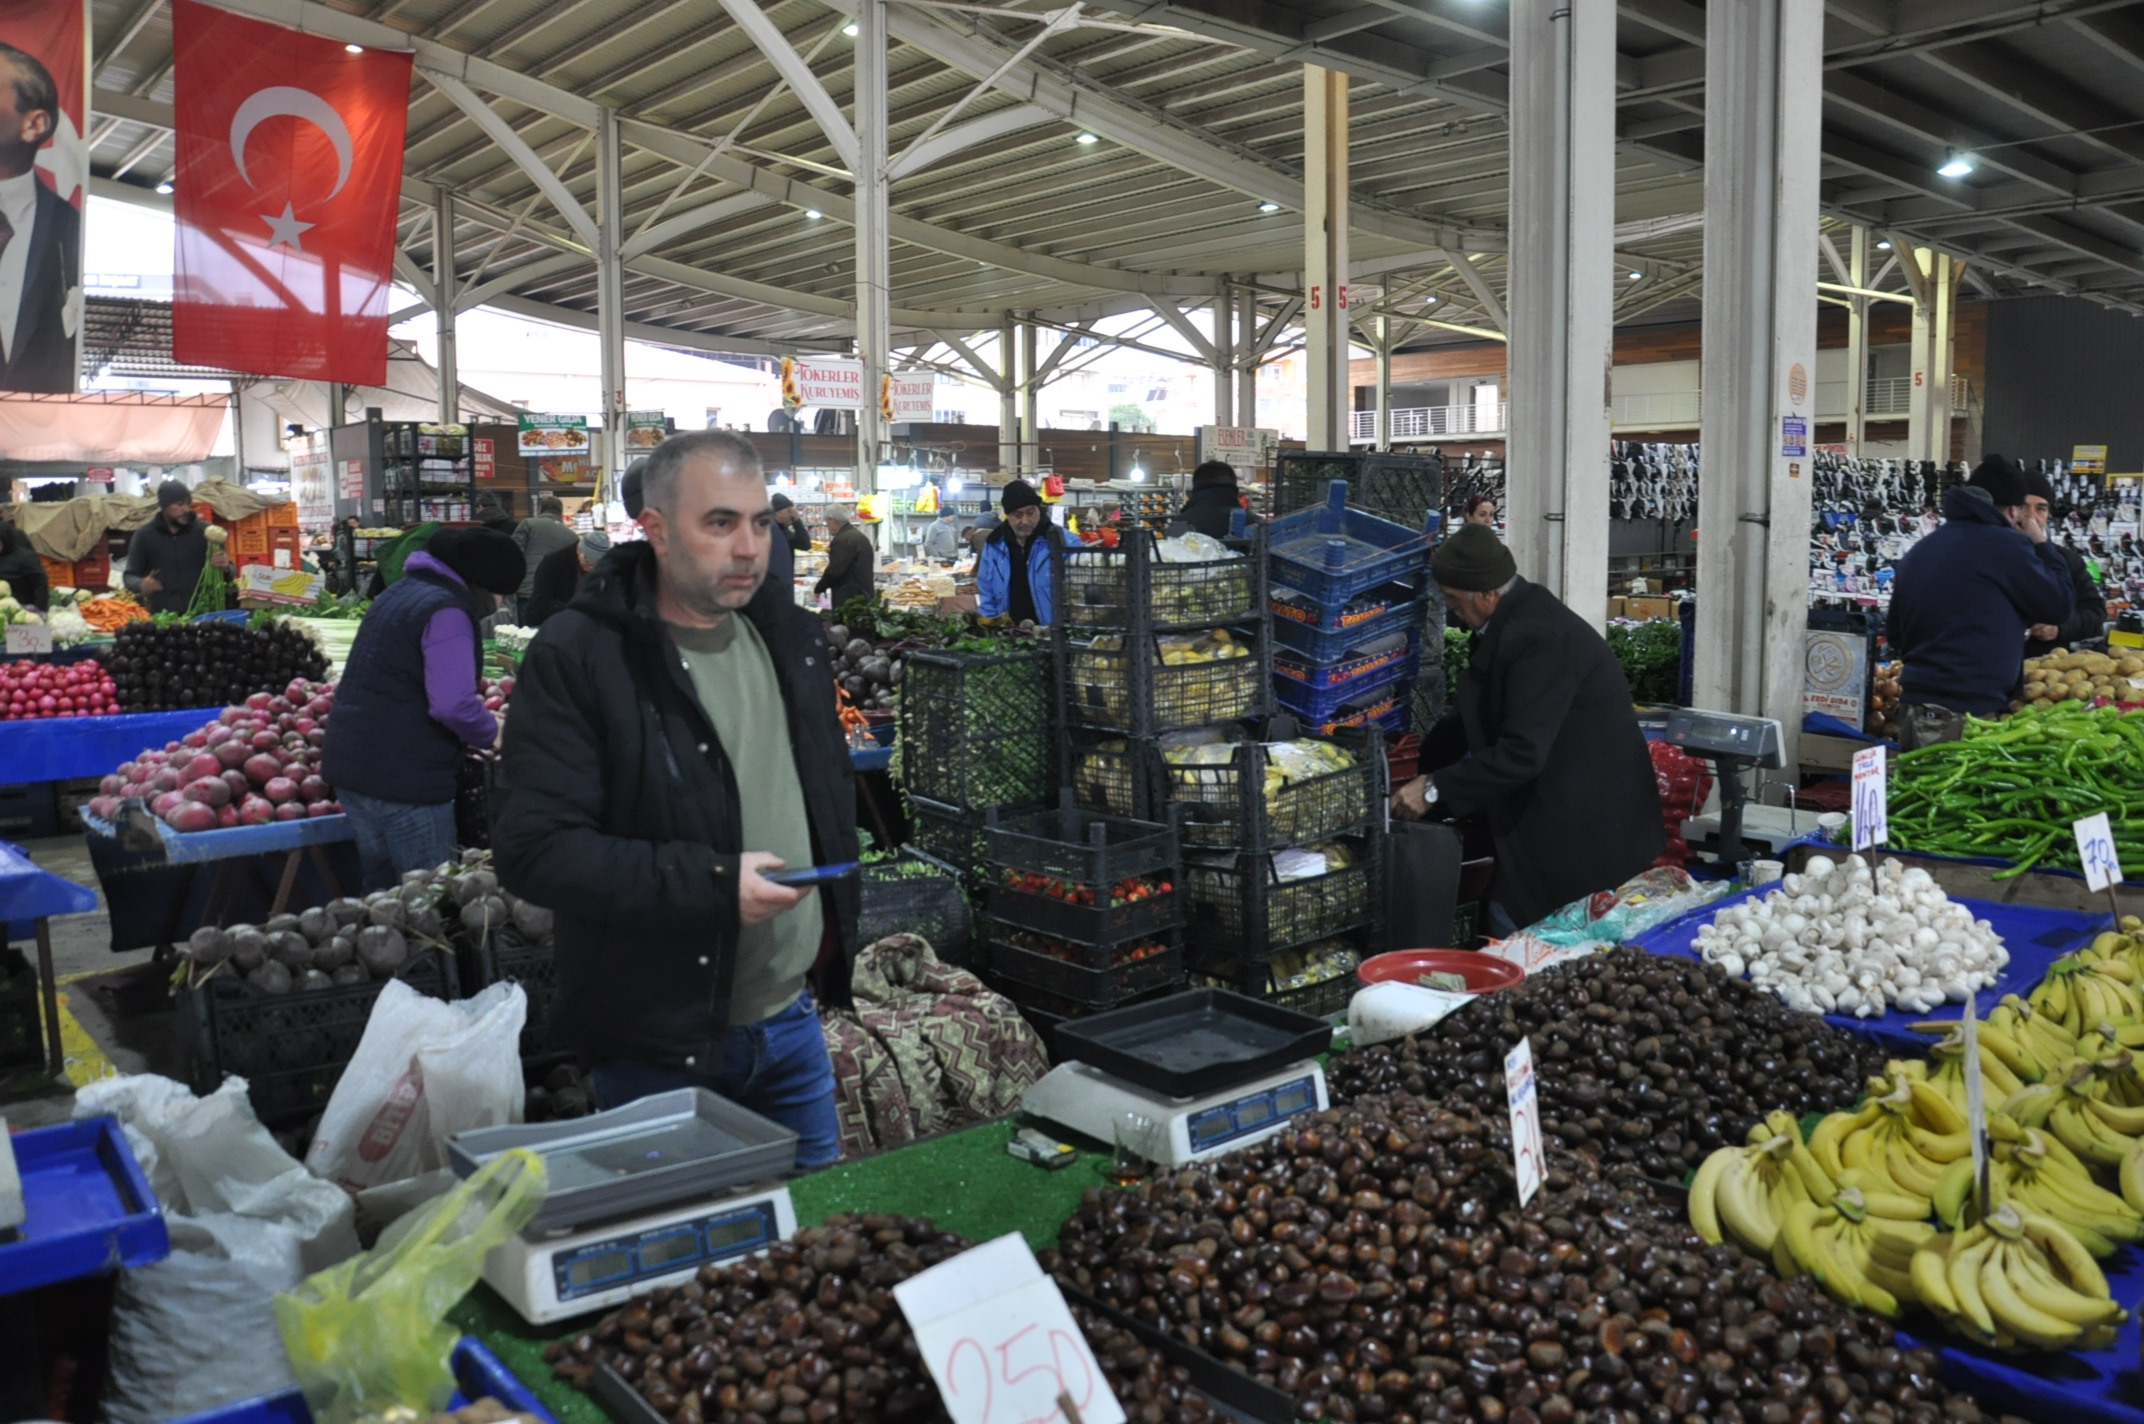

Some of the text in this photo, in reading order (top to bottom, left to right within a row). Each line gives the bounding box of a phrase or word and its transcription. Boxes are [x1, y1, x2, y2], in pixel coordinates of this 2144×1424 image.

[1311, 285, 1320, 310] 5
[1338, 285, 1347, 310] 5
[794, 363, 859, 384] TOKERLER
[1915, 371, 1923, 387] 5
[615, 390, 622, 404] 3
[523, 414, 583, 424] YENER GIDA
